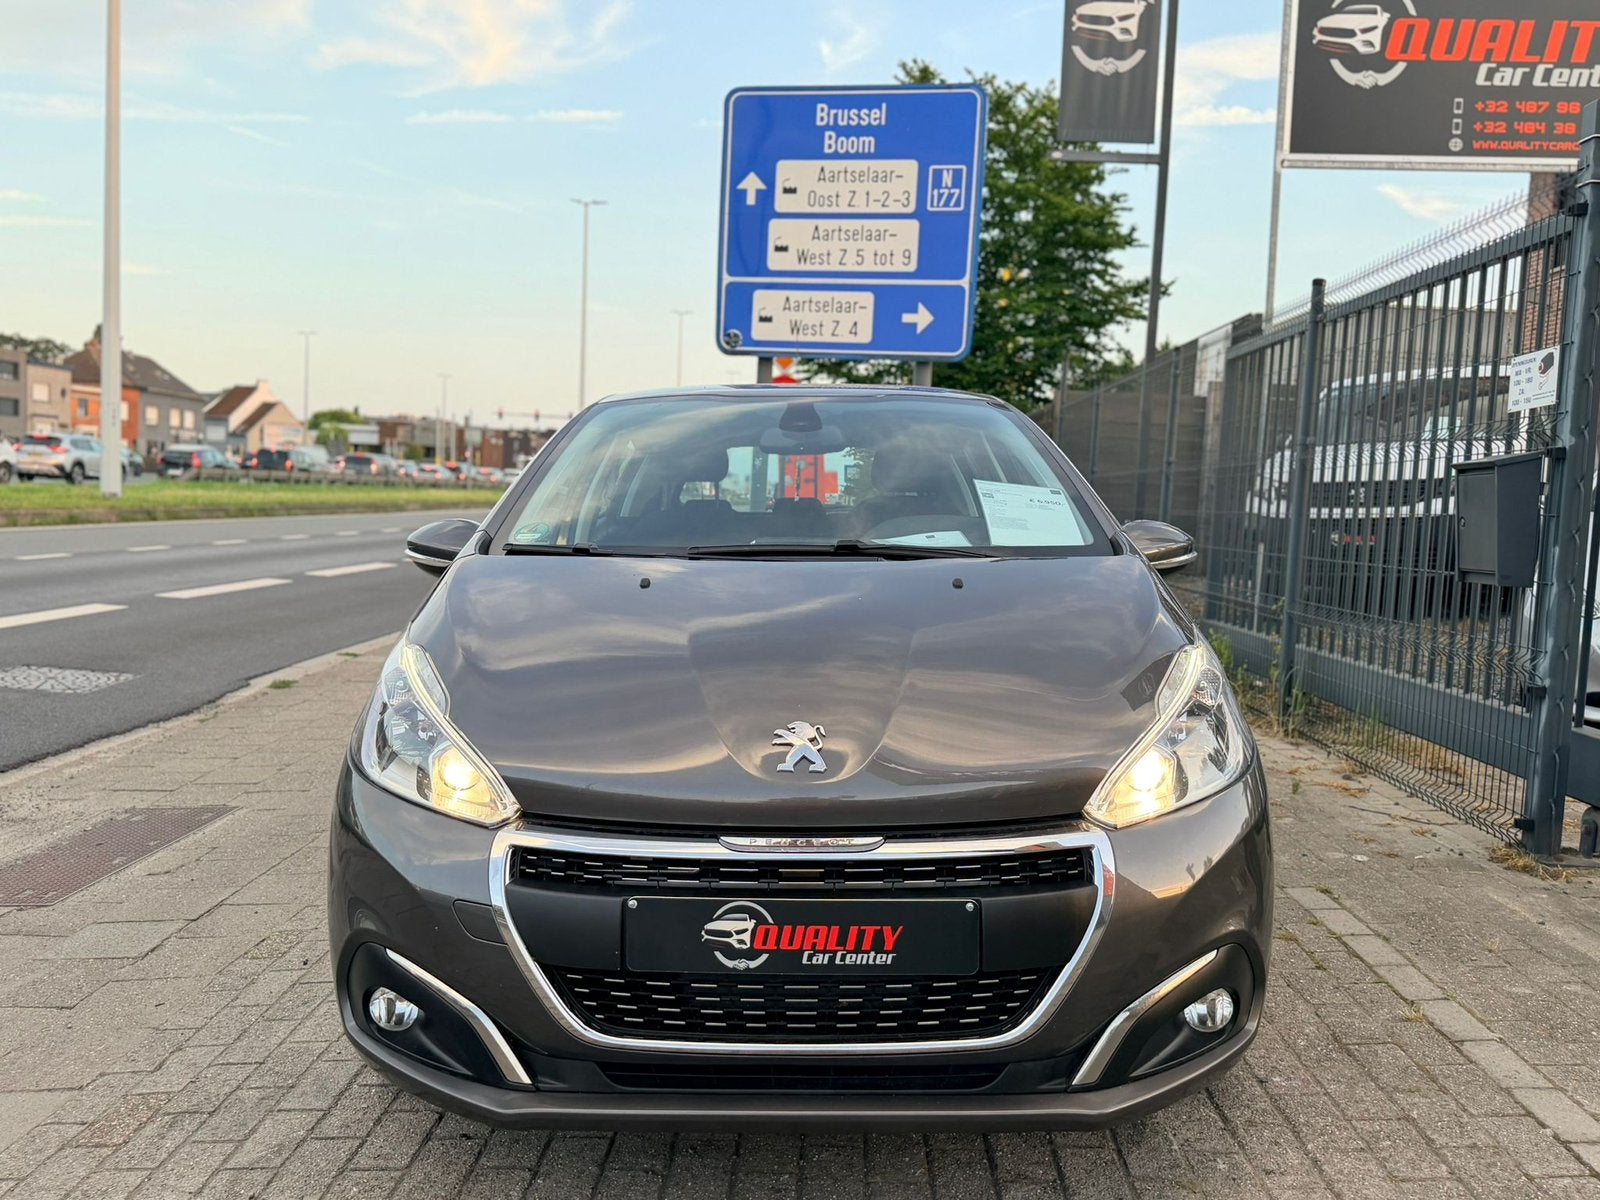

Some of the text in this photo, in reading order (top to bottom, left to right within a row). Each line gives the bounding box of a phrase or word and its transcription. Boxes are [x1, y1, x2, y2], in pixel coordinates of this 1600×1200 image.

[1475, 63, 1530, 87] Car
[816, 103, 887, 126] Brussel
[1474, 101, 1509, 114] +32
[1515, 101, 1550, 114] 487
[1473, 121, 1577, 135] +32 484 38
[823, 131, 875, 154] Boom
[817, 166, 904, 183] Aartselaar-
[942, 169, 953, 188] N
[807, 190, 840, 208] Oost
[865, 190, 911, 208] 1-2-3
[932, 189, 960, 207] 177
[811, 224, 898, 242] Aartselaar-
[796, 248, 831, 266] West
[873, 249, 895, 266] tot
[902, 249, 912, 266] 9
[782, 296, 867, 313] Aartselaar-
[789, 319, 824, 337] West
[849, 320, 858, 338] 4
[753, 925, 904, 951] QUALITY
[802, 951, 897, 965] Car Center
